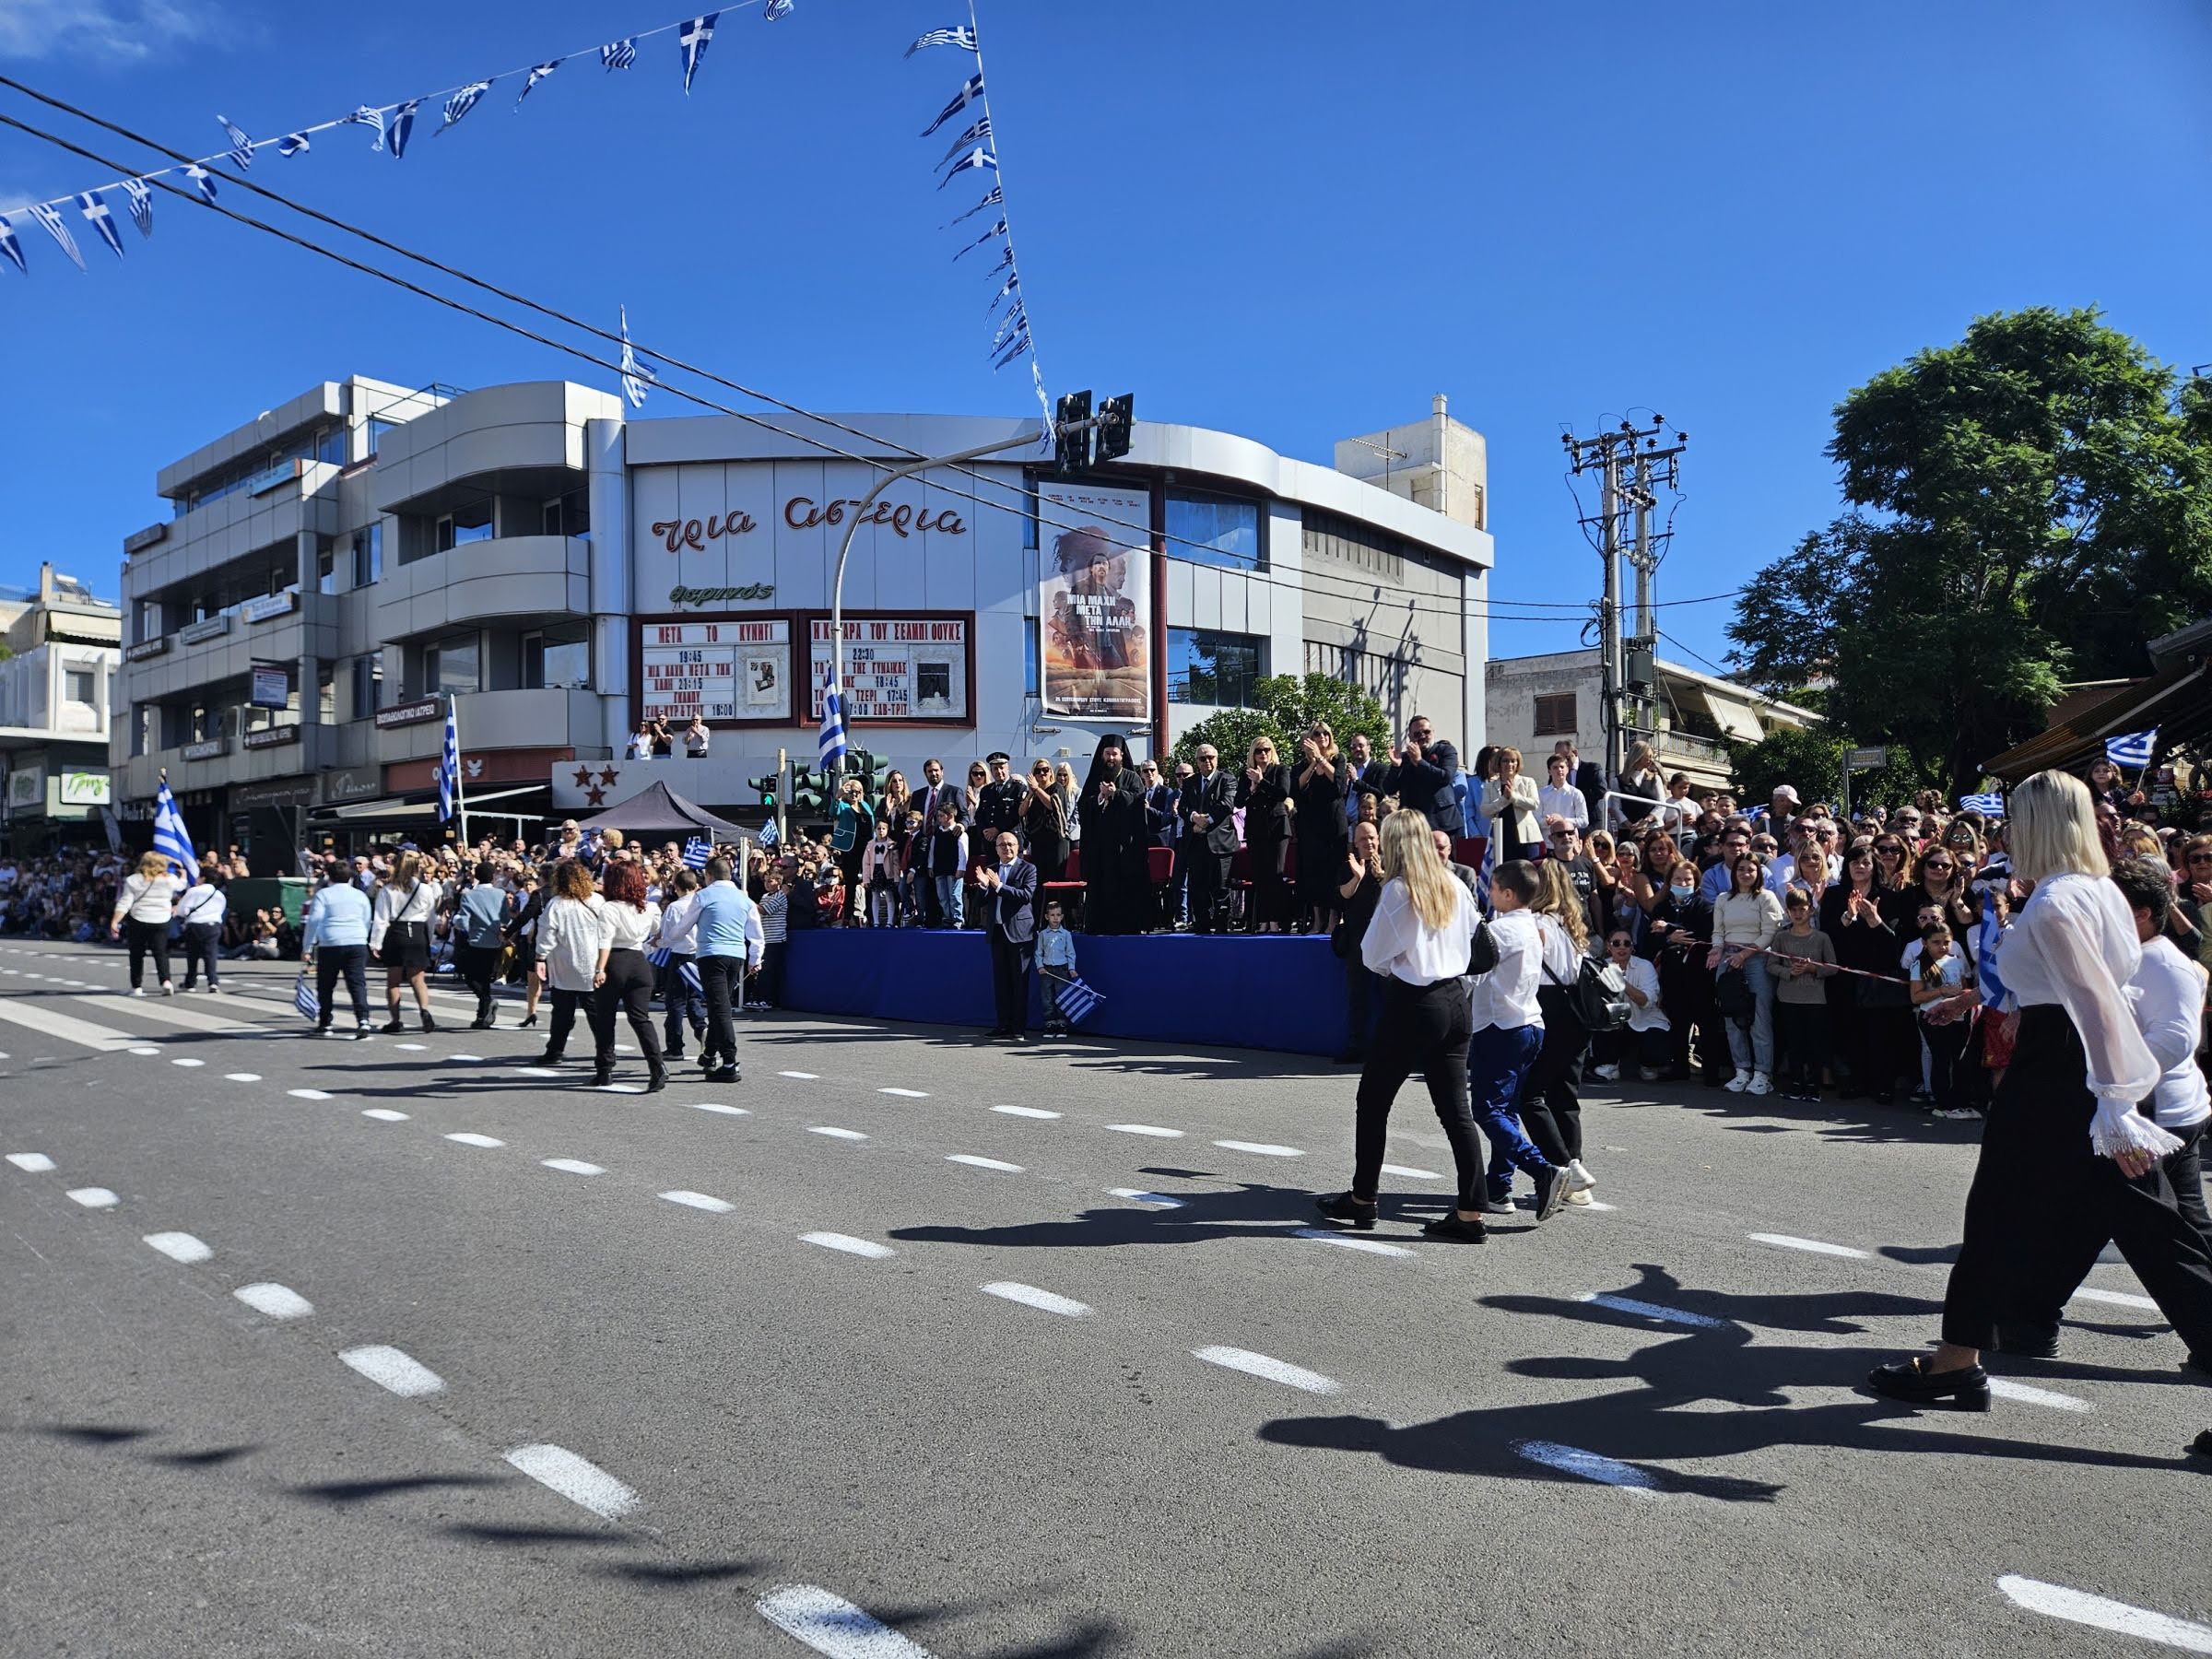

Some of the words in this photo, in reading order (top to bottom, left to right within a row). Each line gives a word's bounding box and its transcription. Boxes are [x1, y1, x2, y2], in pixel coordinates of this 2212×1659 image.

[1067, 594, 1086, 605] ΜΙΑ
[1088, 595, 1116, 606] ΜΑΧΗ
[1077, 605, 1101, 616] ΜΕΤΑ
[1085, 616, 1103, 626] ΤΗΝ
[1106, 617, 1131, 627] ΑΛΛΗ
[658, 627, 682, 643] ΜΕΤΑ
[706, 625, 718, 642] ΤΟ
[814, 622, 819, 640] Η
[823, 622, 862, 640] ΚΑΡΑ
[870, 623, 888, 641] ΤΟΥ
[679, 650, 702, 664] 19:45
[853, 648, 875, 660] 22:30
[689, 663, 710, 677] ΜΕΤΑ
[815, 662, 824, 674] ΤΟ
[853, 662, 866, 674] ΤΗΣ
[678, 677, 702, 690] 21:15
[876, 676, 899, 688] 18:45
[887, 689, 908, 701] 17:45
